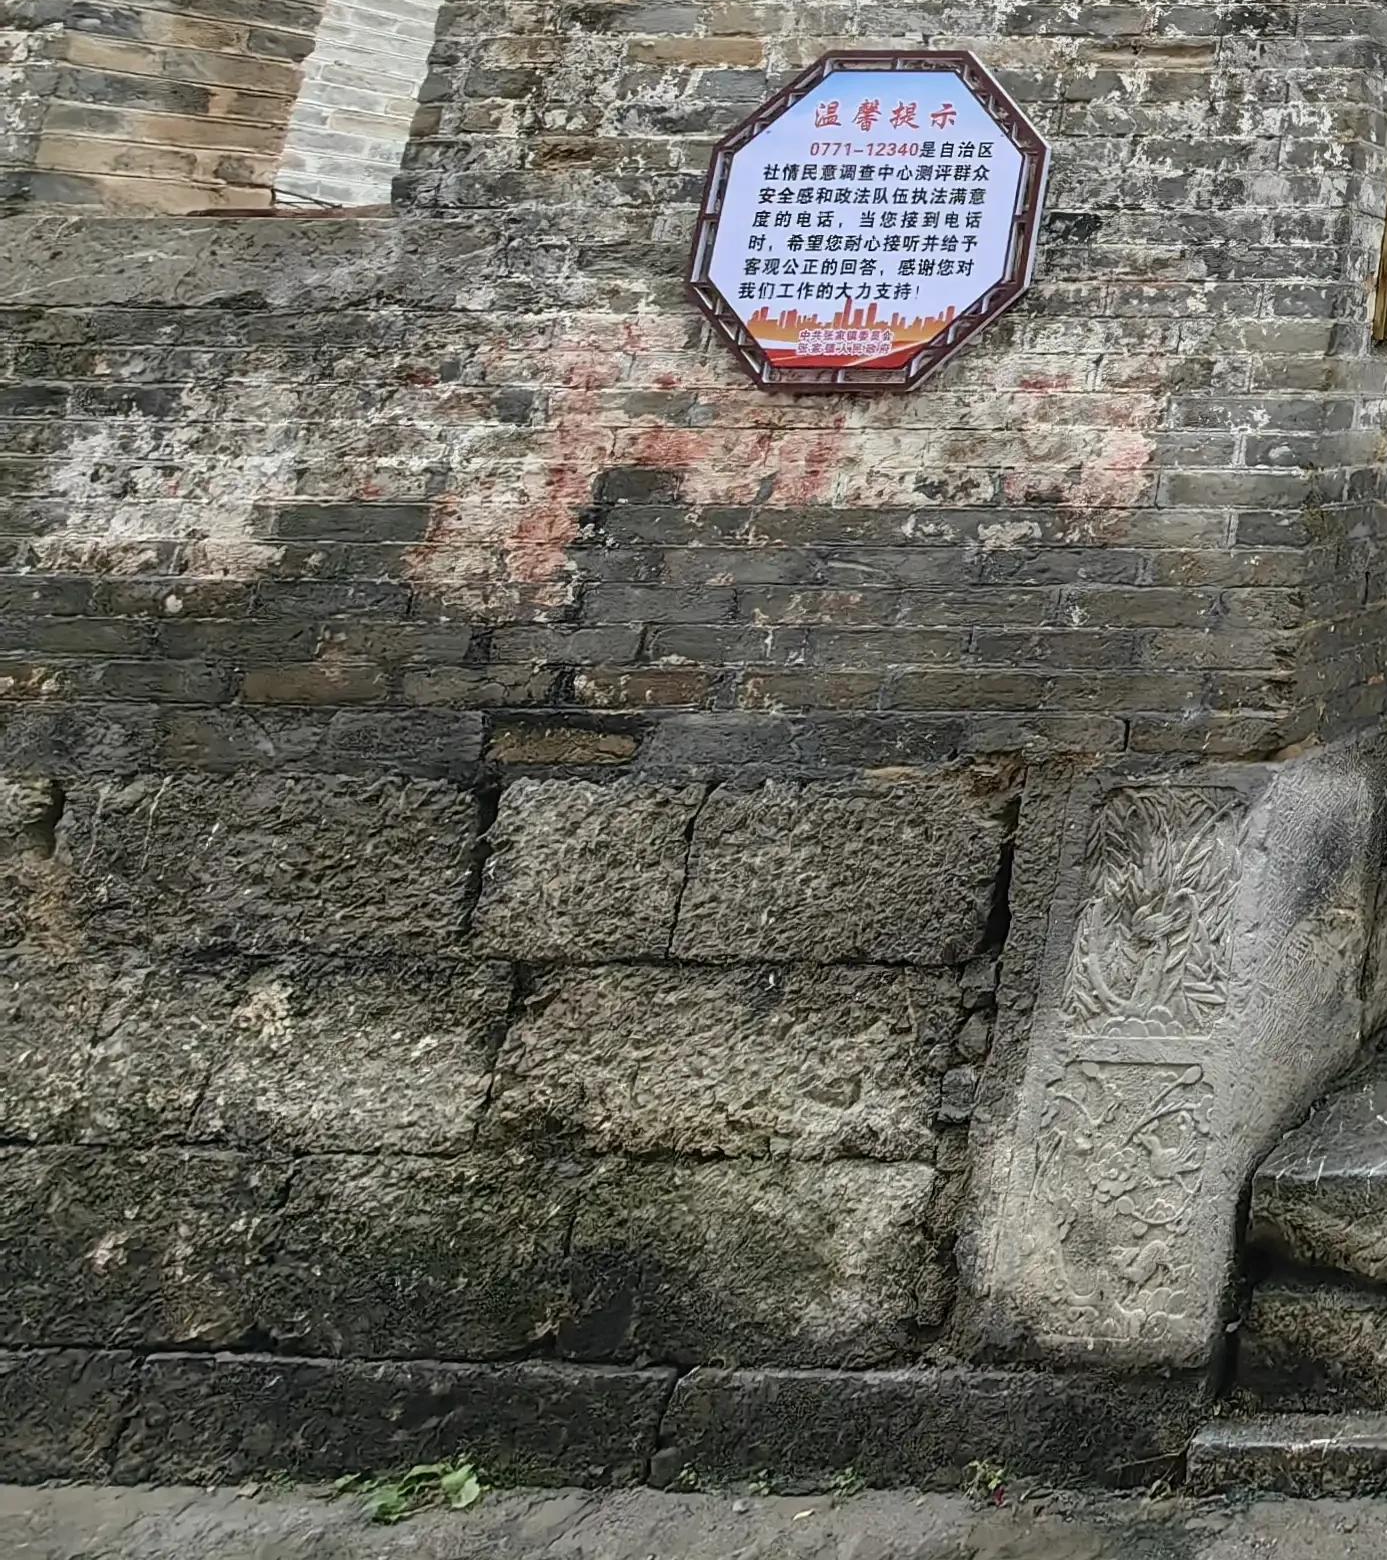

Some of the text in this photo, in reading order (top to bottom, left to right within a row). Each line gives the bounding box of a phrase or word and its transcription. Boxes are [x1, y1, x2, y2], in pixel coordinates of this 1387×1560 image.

[815, 95, 956, 131] 温馨提示
[810, 141, 994, 158] 0771-12340是自治区
[763, 164, 990, 182] 社情民意调查中心测评群众
[758, 187, 986, 205] 安全感和政法队伍执法满意
[752, 210, 982, 228] 度的电话，当您接到电话
[748, 234, 978, 252] 时，希望您耐心接听并给予
[744, 258, 974, 276] 客观公正的回答，感谢您对
